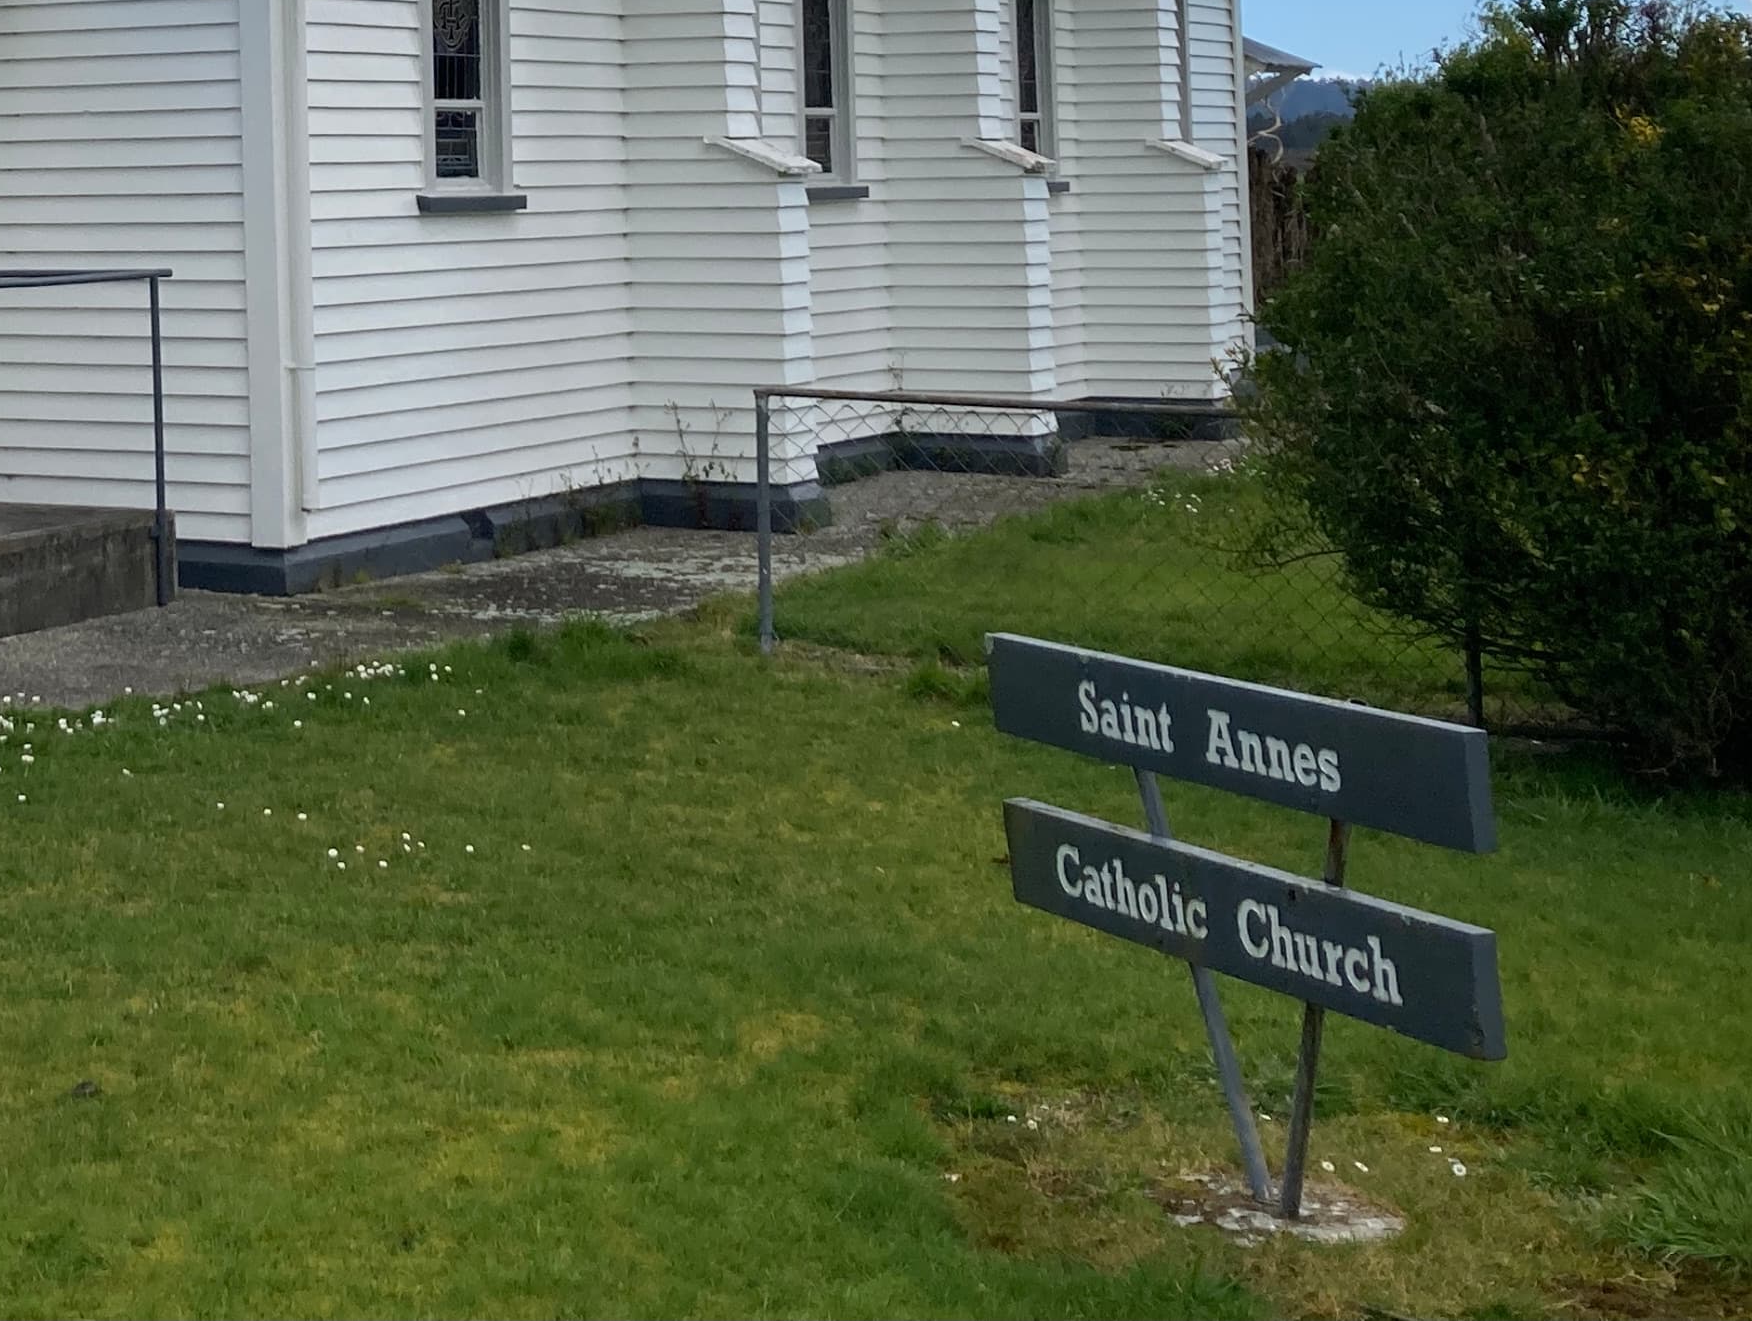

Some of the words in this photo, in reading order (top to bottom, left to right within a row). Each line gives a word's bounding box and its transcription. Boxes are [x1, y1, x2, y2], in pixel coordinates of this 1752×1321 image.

[1078, 680, 1174, 752] Saint
[1206, 709, 1341, 792] Annes
[1056, 844, 1208, 940] Catholic
[1237, 900, 1403, 1006] Church
